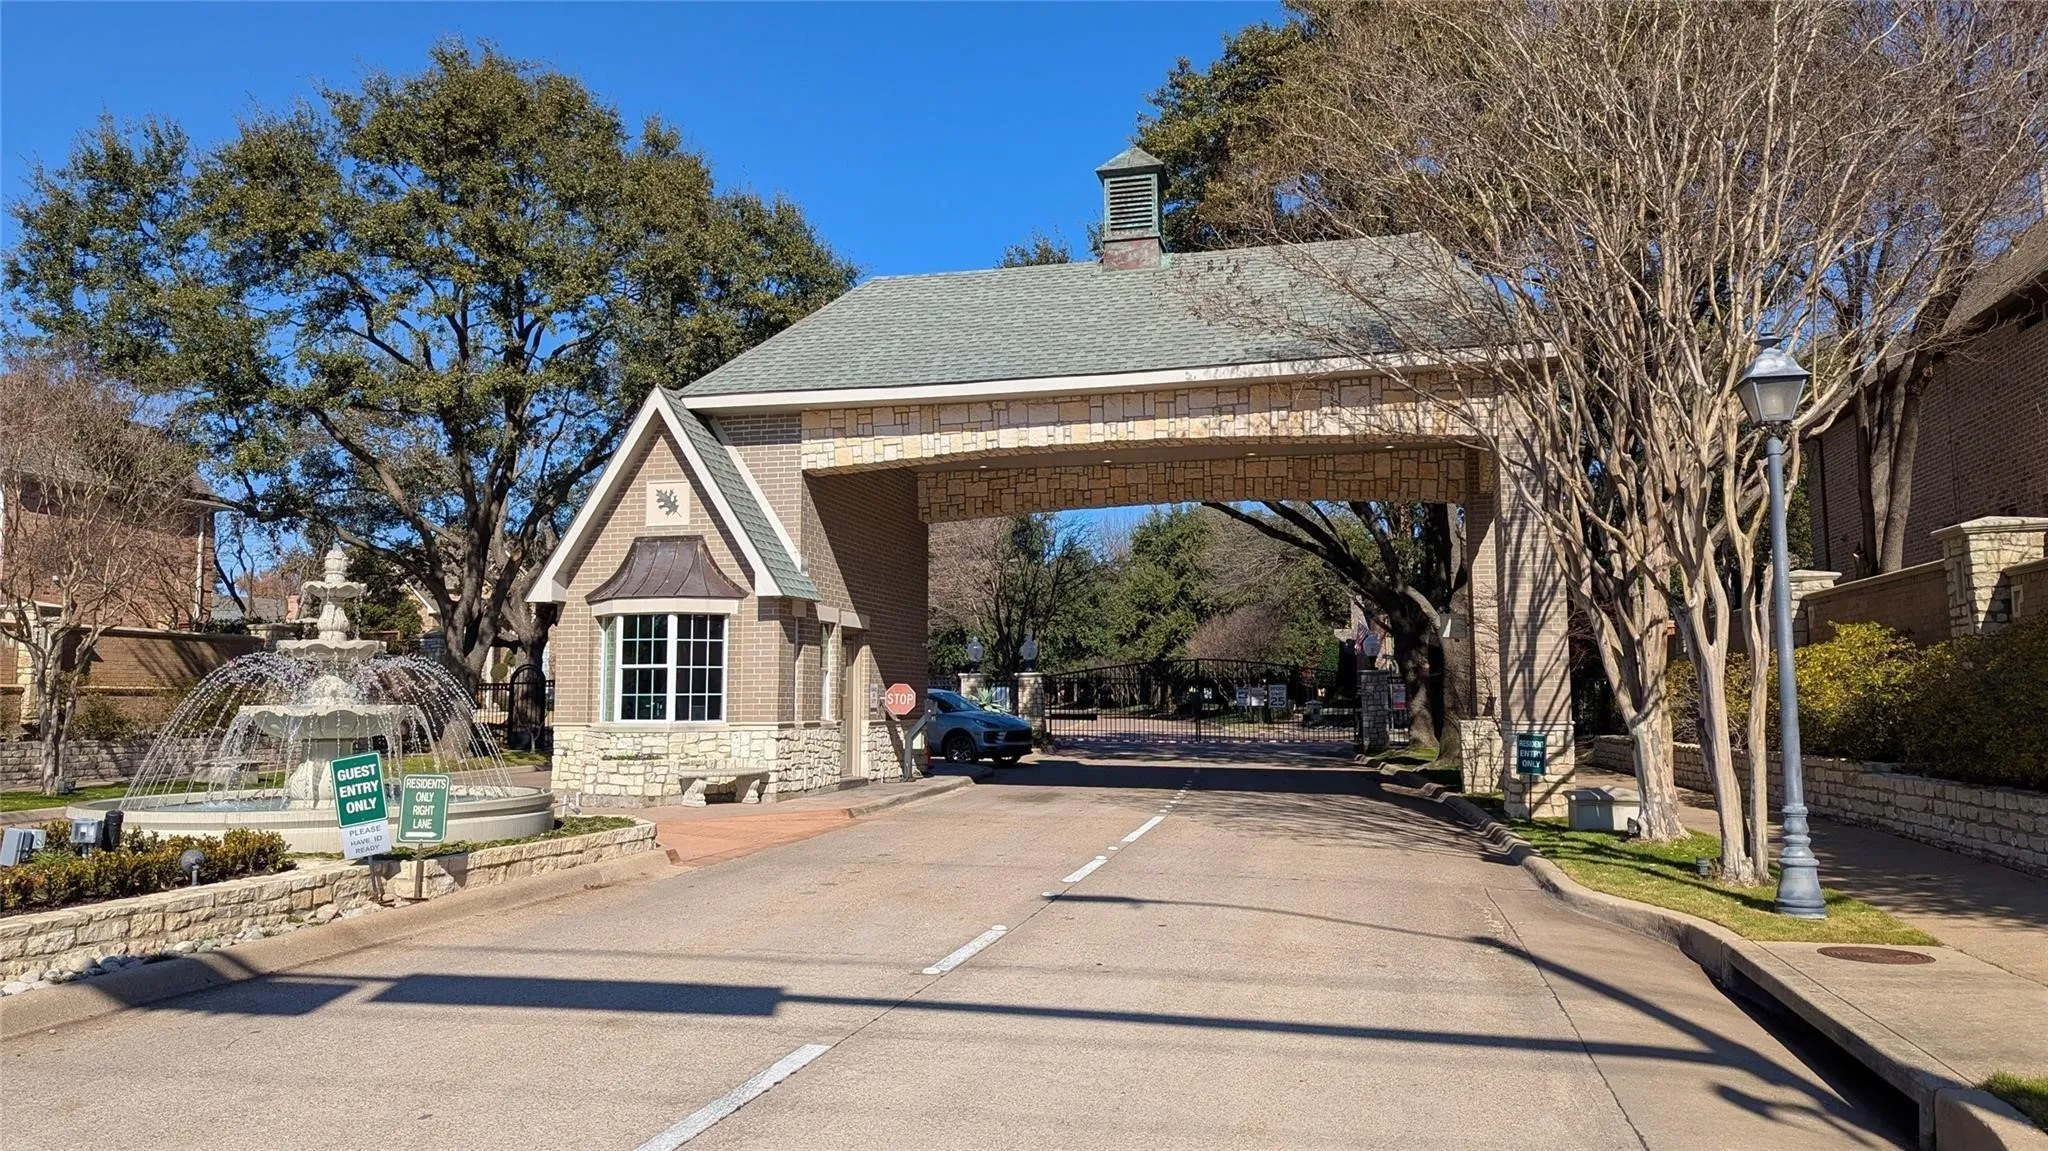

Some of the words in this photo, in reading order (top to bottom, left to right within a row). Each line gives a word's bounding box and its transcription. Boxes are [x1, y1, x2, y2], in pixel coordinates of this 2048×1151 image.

[887, 693, 914, 705] STOP
[1270, 696, 1285, 706] 25
[1522, 760, 1541, 768] ONLY
[337, 763, 376, 781] GUEST
[339, 780, 379, 798] ENTRY
[406, 778, 446, 789] RESIDENTS
[415, 792, 435, 802] ONLY
[346, 797, 377, 814] ONLY
[412, 805, 435, 816] RIGHT
[412, 818, 432, 829] LANE
[349, 824, 382, 837] PLEASE
[350, 838, 371, 847] HAVE
[355, 844, 380, 854] READY
